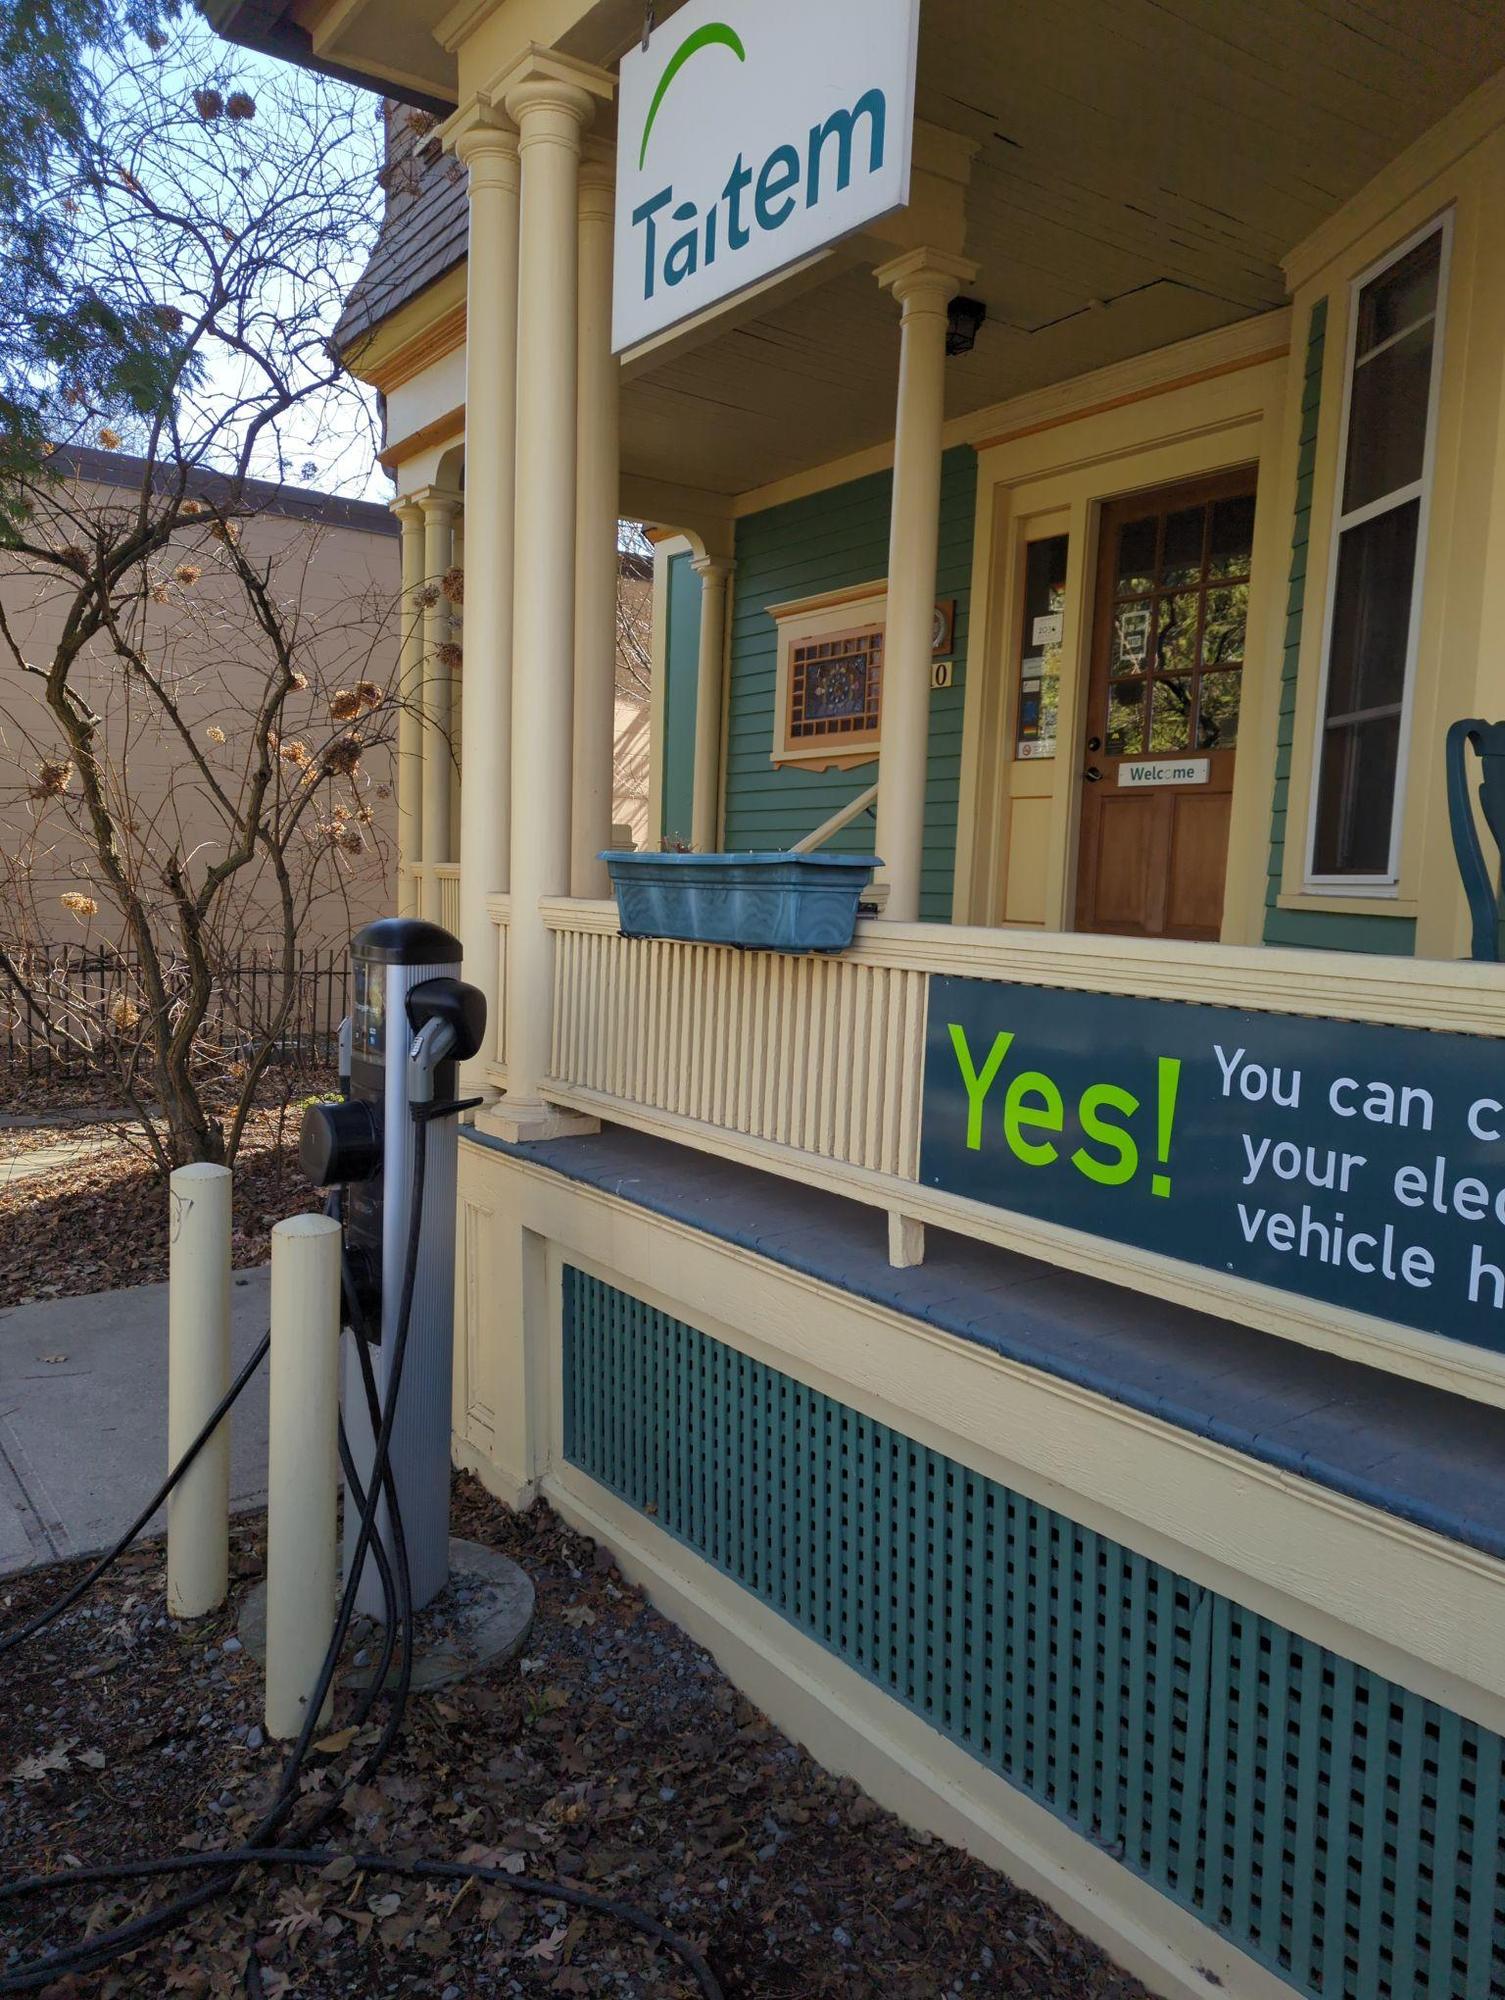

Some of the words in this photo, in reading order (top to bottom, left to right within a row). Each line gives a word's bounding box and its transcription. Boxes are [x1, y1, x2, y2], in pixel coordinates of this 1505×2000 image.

[632, 88, 886, 300] Taitem
[947, 1023, 1182, 1199] Yes!
[1213, 1044, 1301, 1108] You
[1329, 1077, 1434, 1131] can
[1467, 1098, 1505, 1141] c
[1242, 1133, 1368, 1193] your
[1237, 1203, 1436, 1288] vehicle
[1468, 1244, 1505, 1309] h
